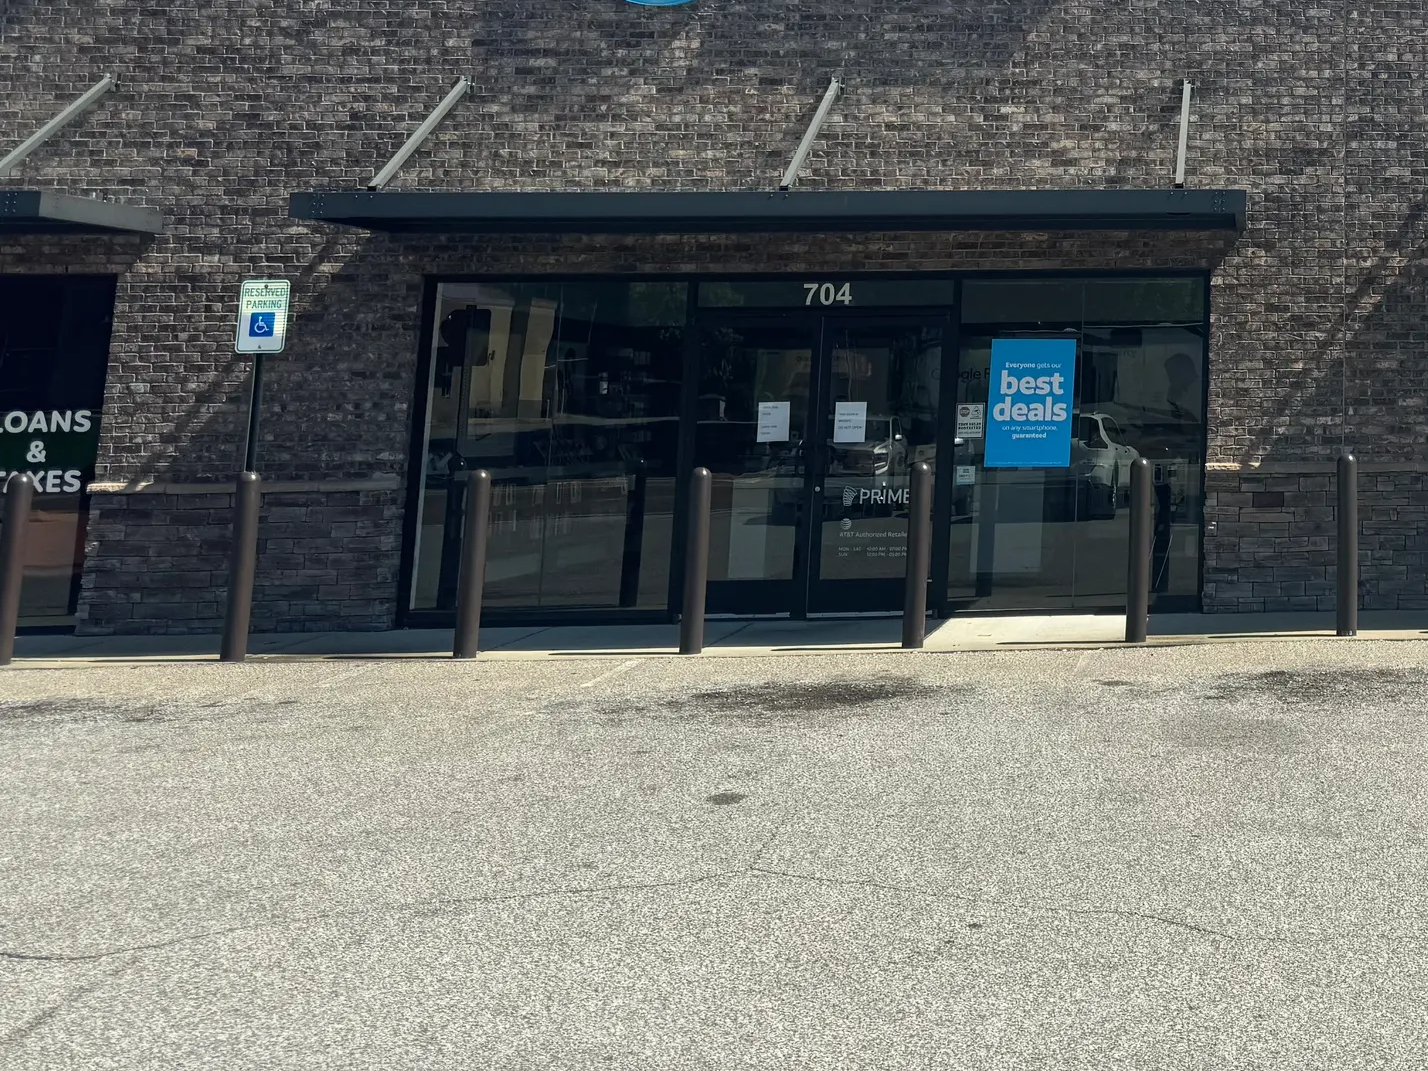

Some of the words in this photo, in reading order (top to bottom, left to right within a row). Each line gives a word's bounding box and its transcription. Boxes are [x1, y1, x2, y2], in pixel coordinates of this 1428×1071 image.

[244, 287, 286, 298] RESERVED
[803, 282, 852, 306] 704
[246, 299, 282, 309] PARKING
[1005, 361, 1036, 370] Everyone
[1036, 361, 1050, 370] gets
[1000, 369, 1065, 395] best
[992, 396, 1068, 422] deals
[0, 410, 92, 433] OANS
[1011, 432, 1047, 440] guaranteed
[26, 440, 47, 463] &
[859, 488, 910, 505] PRIME
